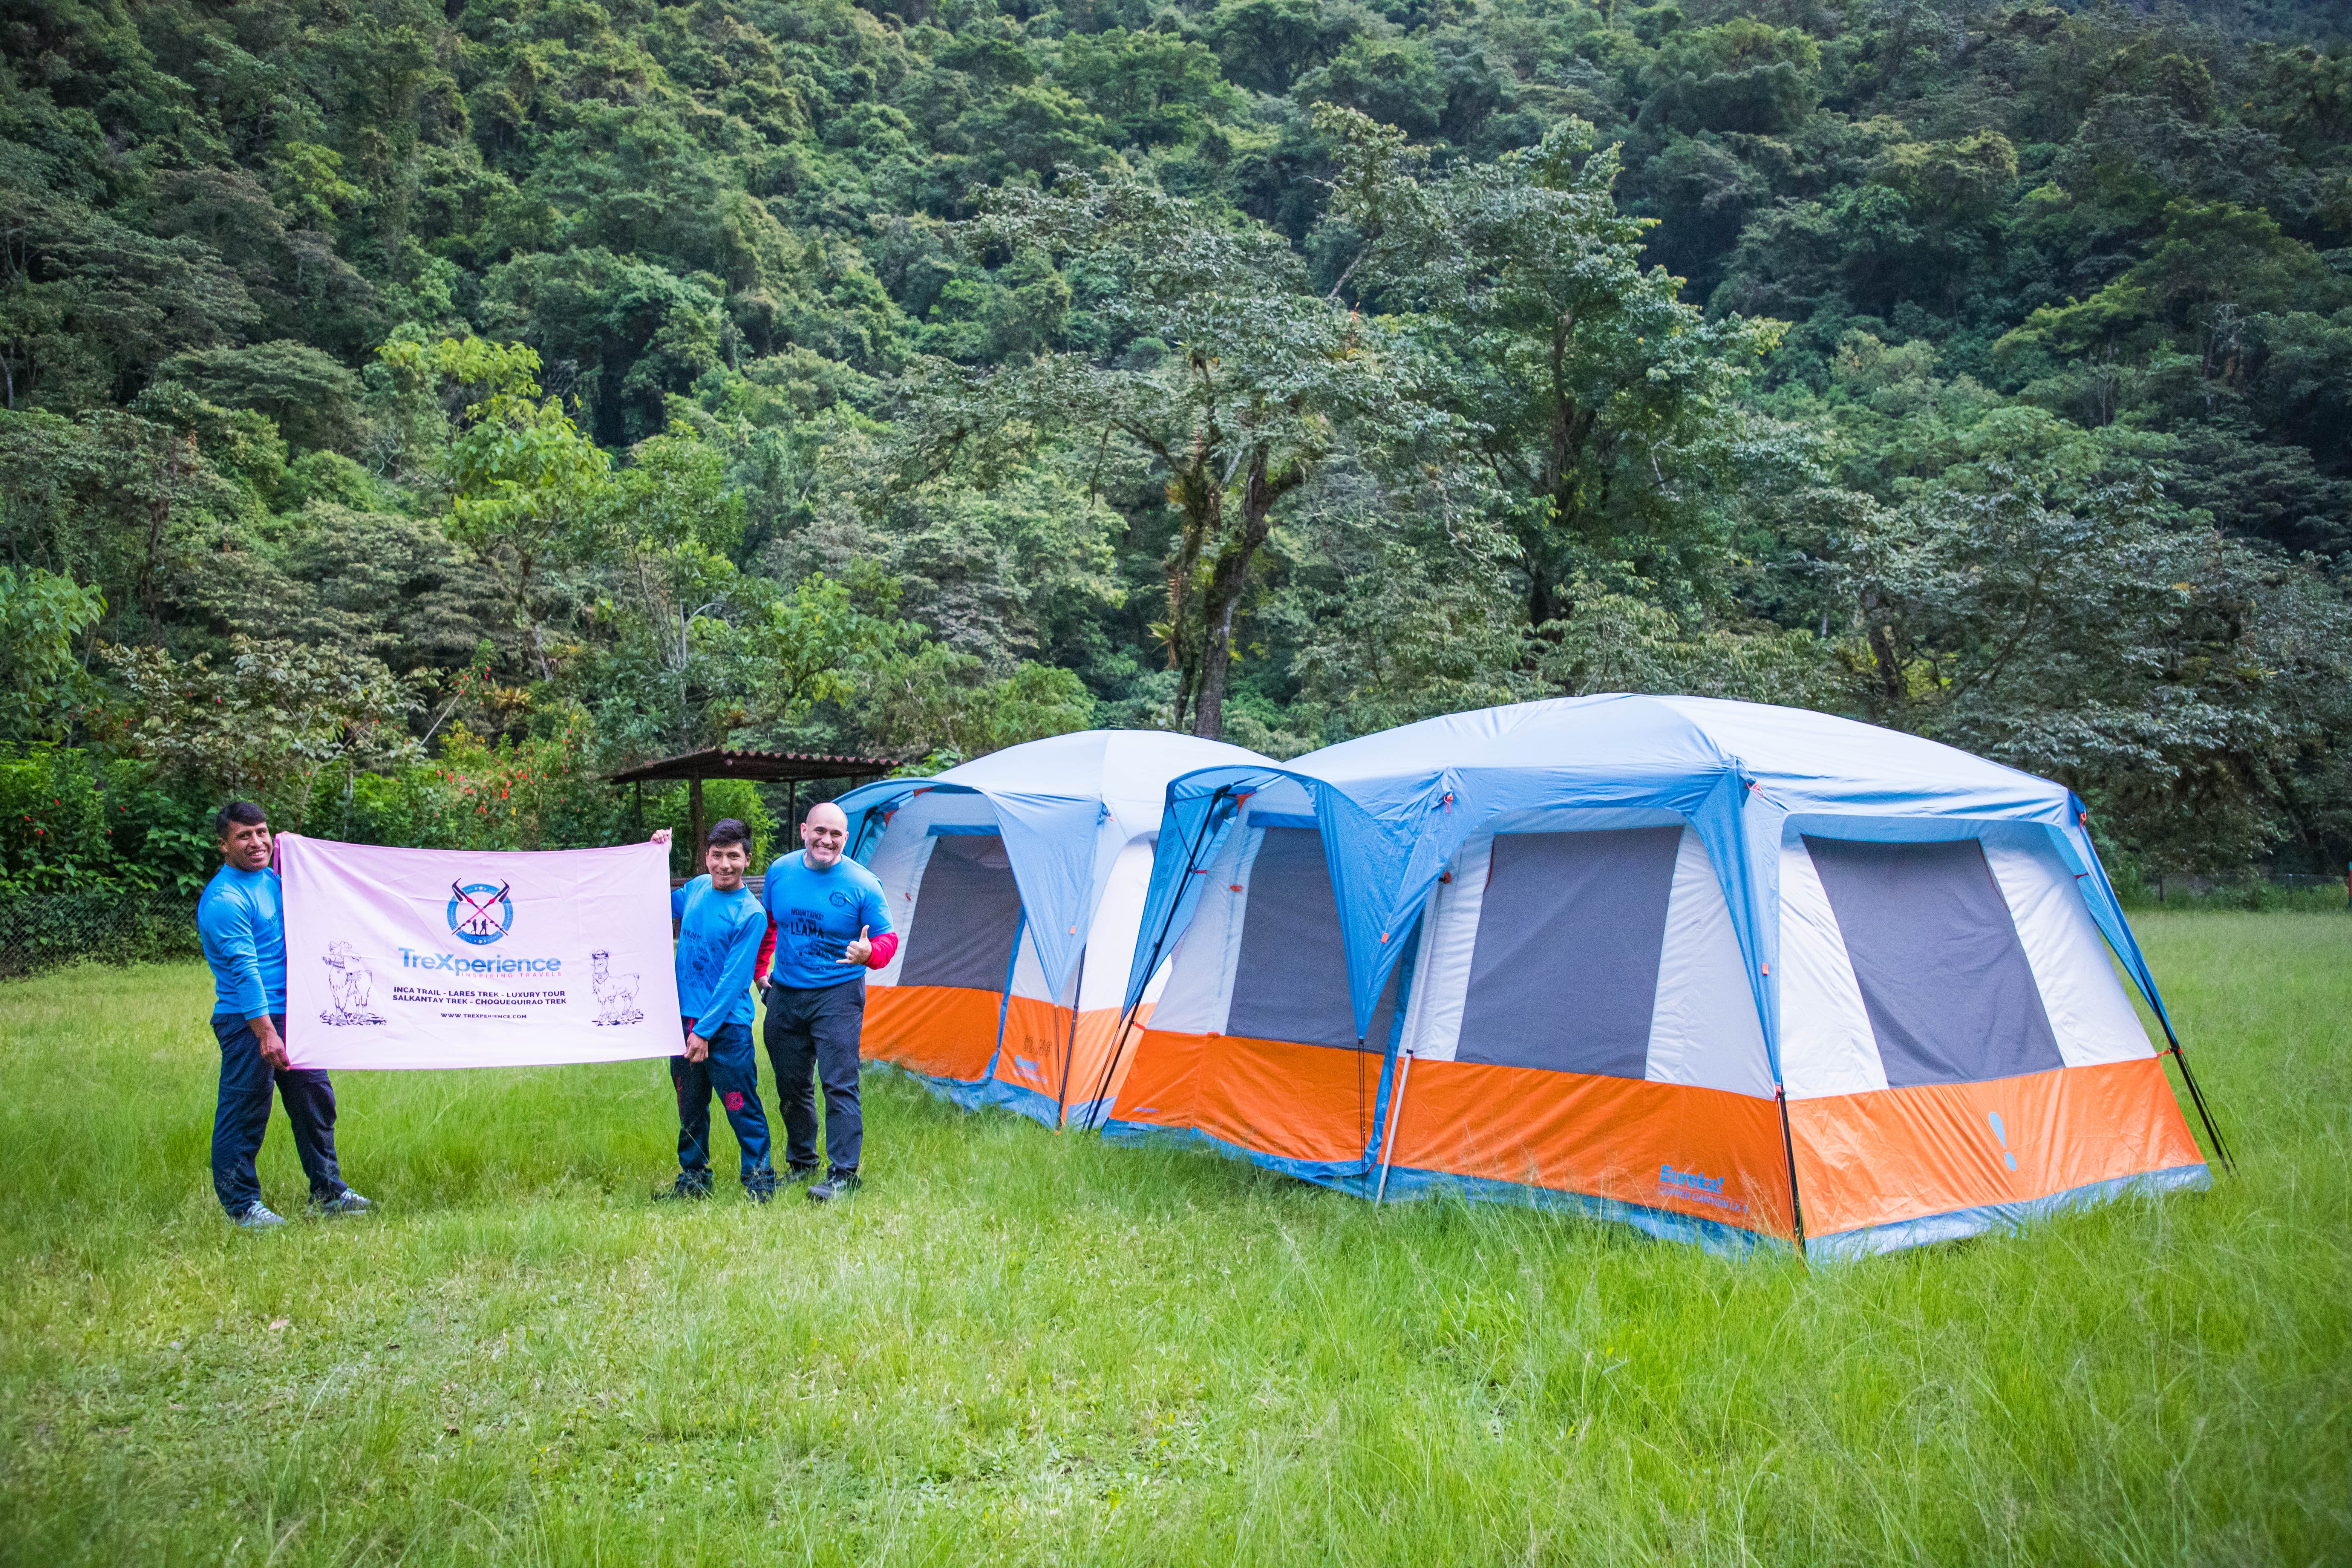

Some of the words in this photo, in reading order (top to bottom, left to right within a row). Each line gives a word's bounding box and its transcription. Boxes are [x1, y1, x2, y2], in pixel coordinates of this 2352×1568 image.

[791, 908, 824, 920] MOUNTAINS?
[790, 922, 824, 939] LLAMA
[398, 947, 561, 976] TreXperience
[393, 995, 443, 1003] SALKANTAY
[1659, 1165, 1724, 1194] Eureka!
[1658, 1186, 1691, 1199] COPPER
[1692, 1193, 1729, 1208] CANYON
